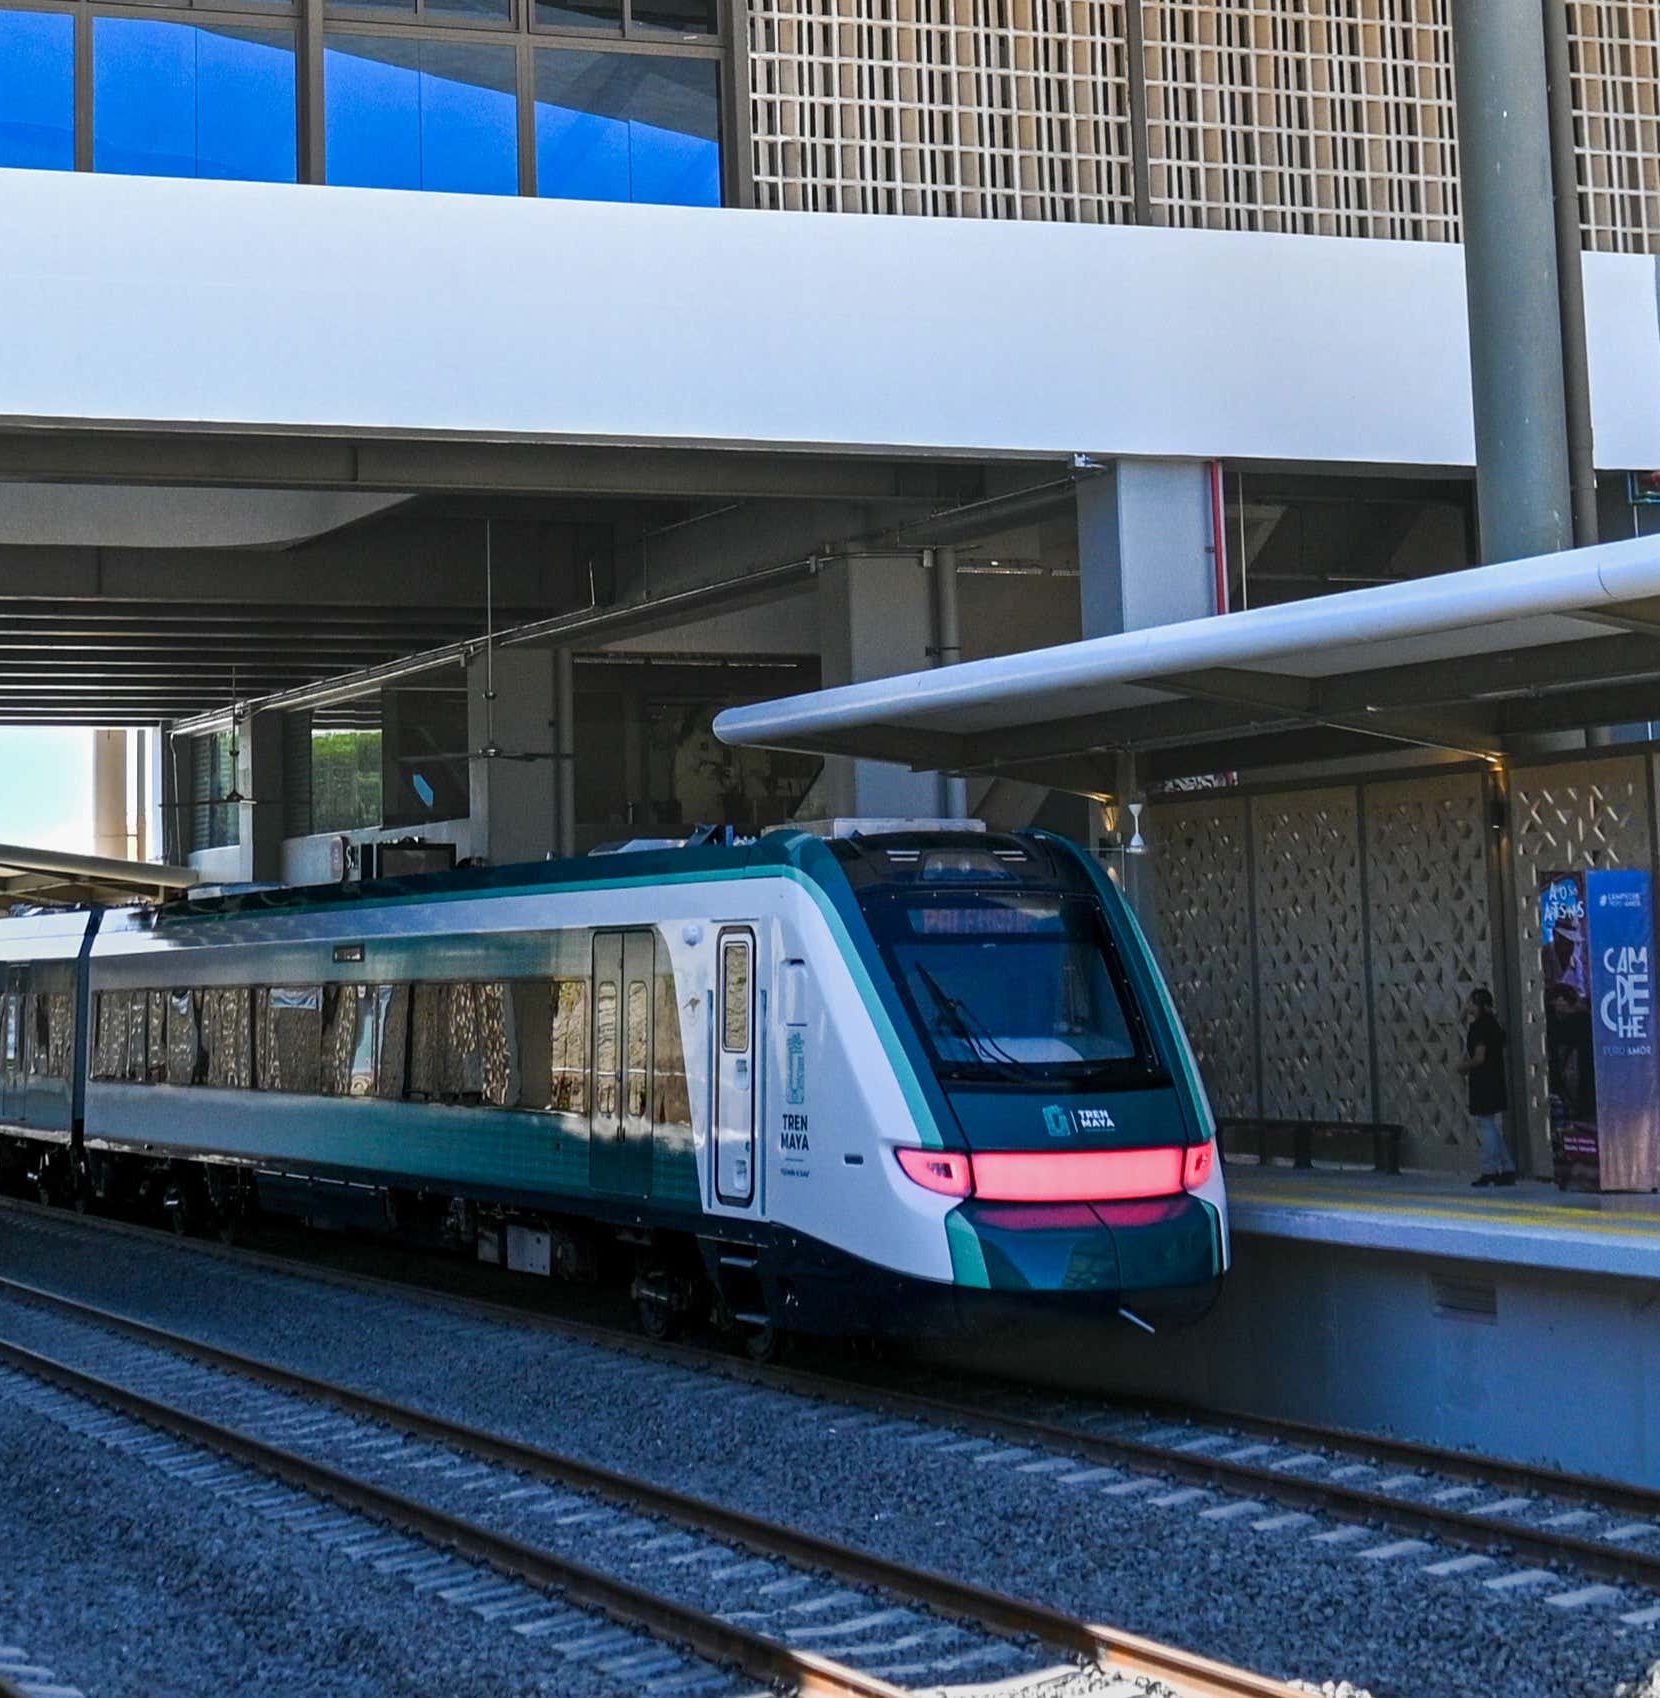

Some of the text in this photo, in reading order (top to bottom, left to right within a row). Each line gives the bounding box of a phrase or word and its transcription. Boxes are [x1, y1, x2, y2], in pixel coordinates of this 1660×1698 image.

[1627, 1045, 1652, 1056] AMOR
[1078, 1109, 1109, 1119] TREN
[782, 1114, 808, 1132] TREN
[1081, 1118, 1115, 1128] MAYA
[780, 1132, 810, 1151] MAYA
